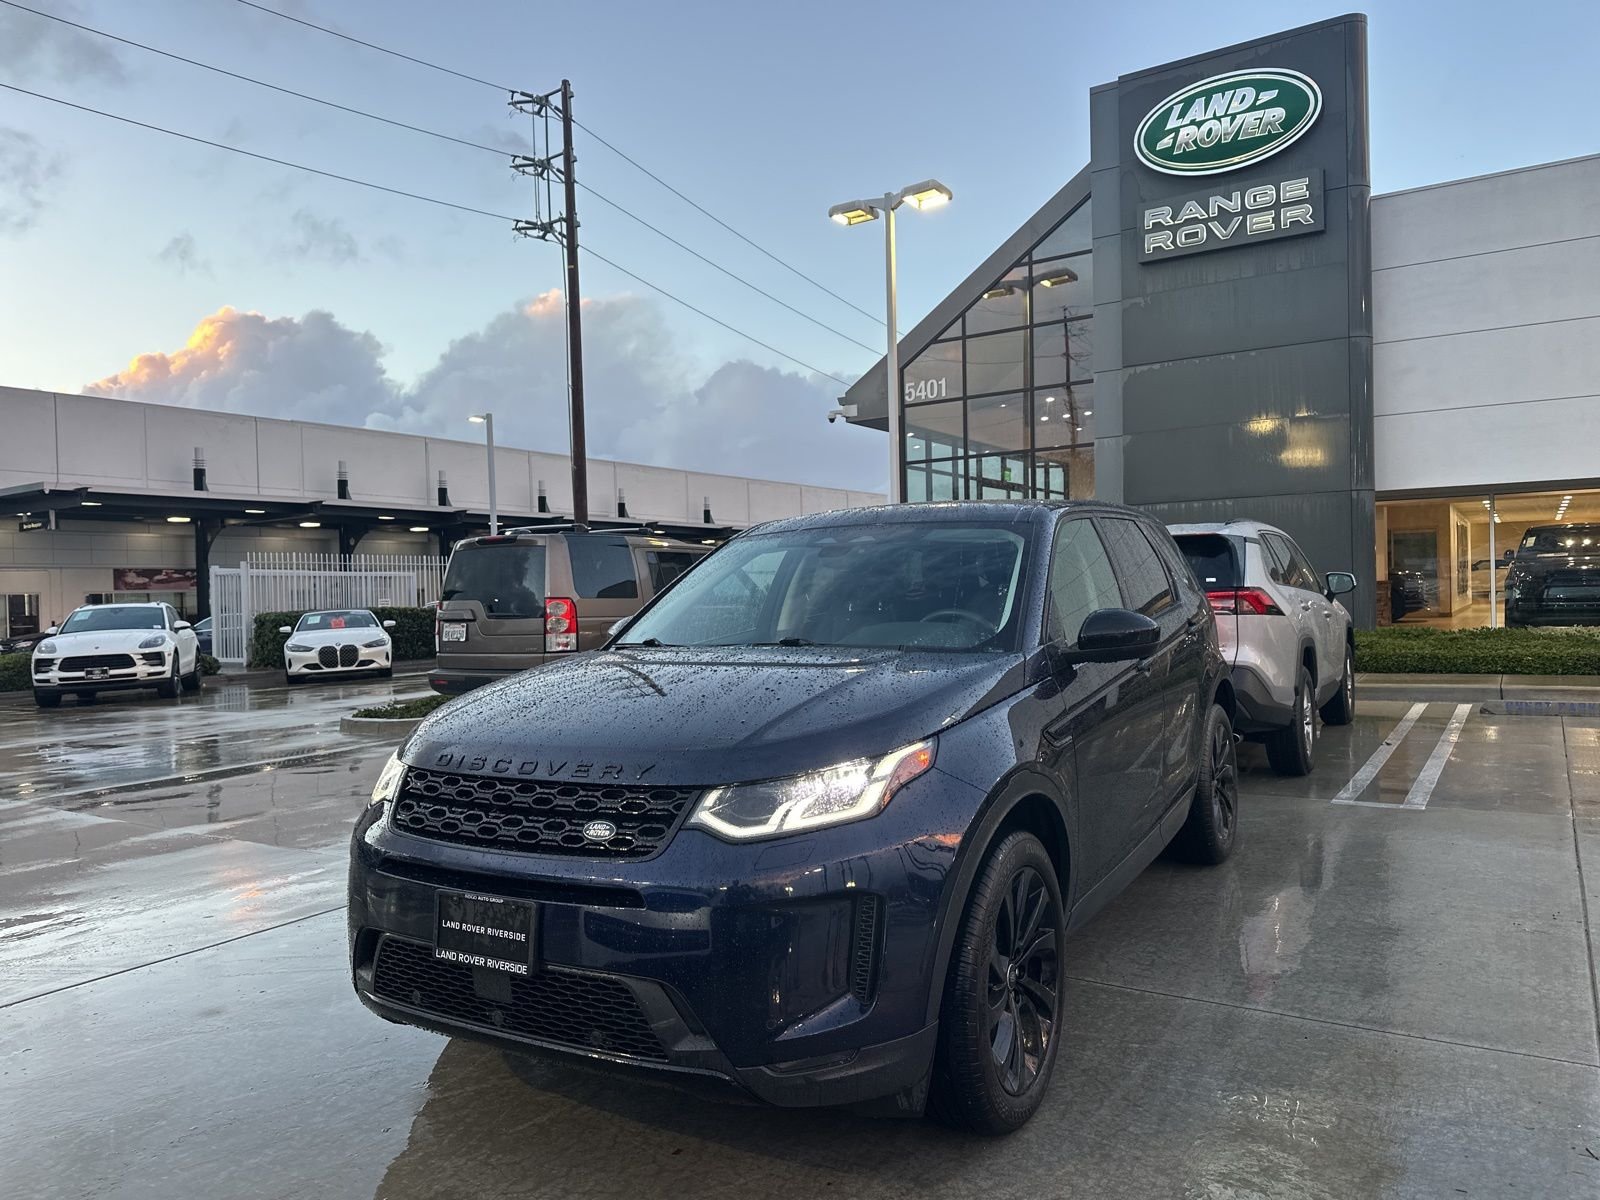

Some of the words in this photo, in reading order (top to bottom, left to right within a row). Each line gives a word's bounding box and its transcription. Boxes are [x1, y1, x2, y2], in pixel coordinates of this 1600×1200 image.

[1165, 87, 1255, 130] LAND
[1173, 107, 1286, 155] ROVER
[1145, 177, 1309, 229] RANGE
[1145, 204, 1314, 253] ROVER
[905, 377, 946, 401] 5401
[435, 753, 656, 780] DISCOVERY
[442, 920, 460, 930] LAND
[462, 923, 485, 935] ROVER
[487, 928, 526, 942] RIVERSIDE
[435, 948, 457, 961] LAND
[458, 953, 485, 967] ROVER
[486, 959, 528, 975] RIVERSIDE
